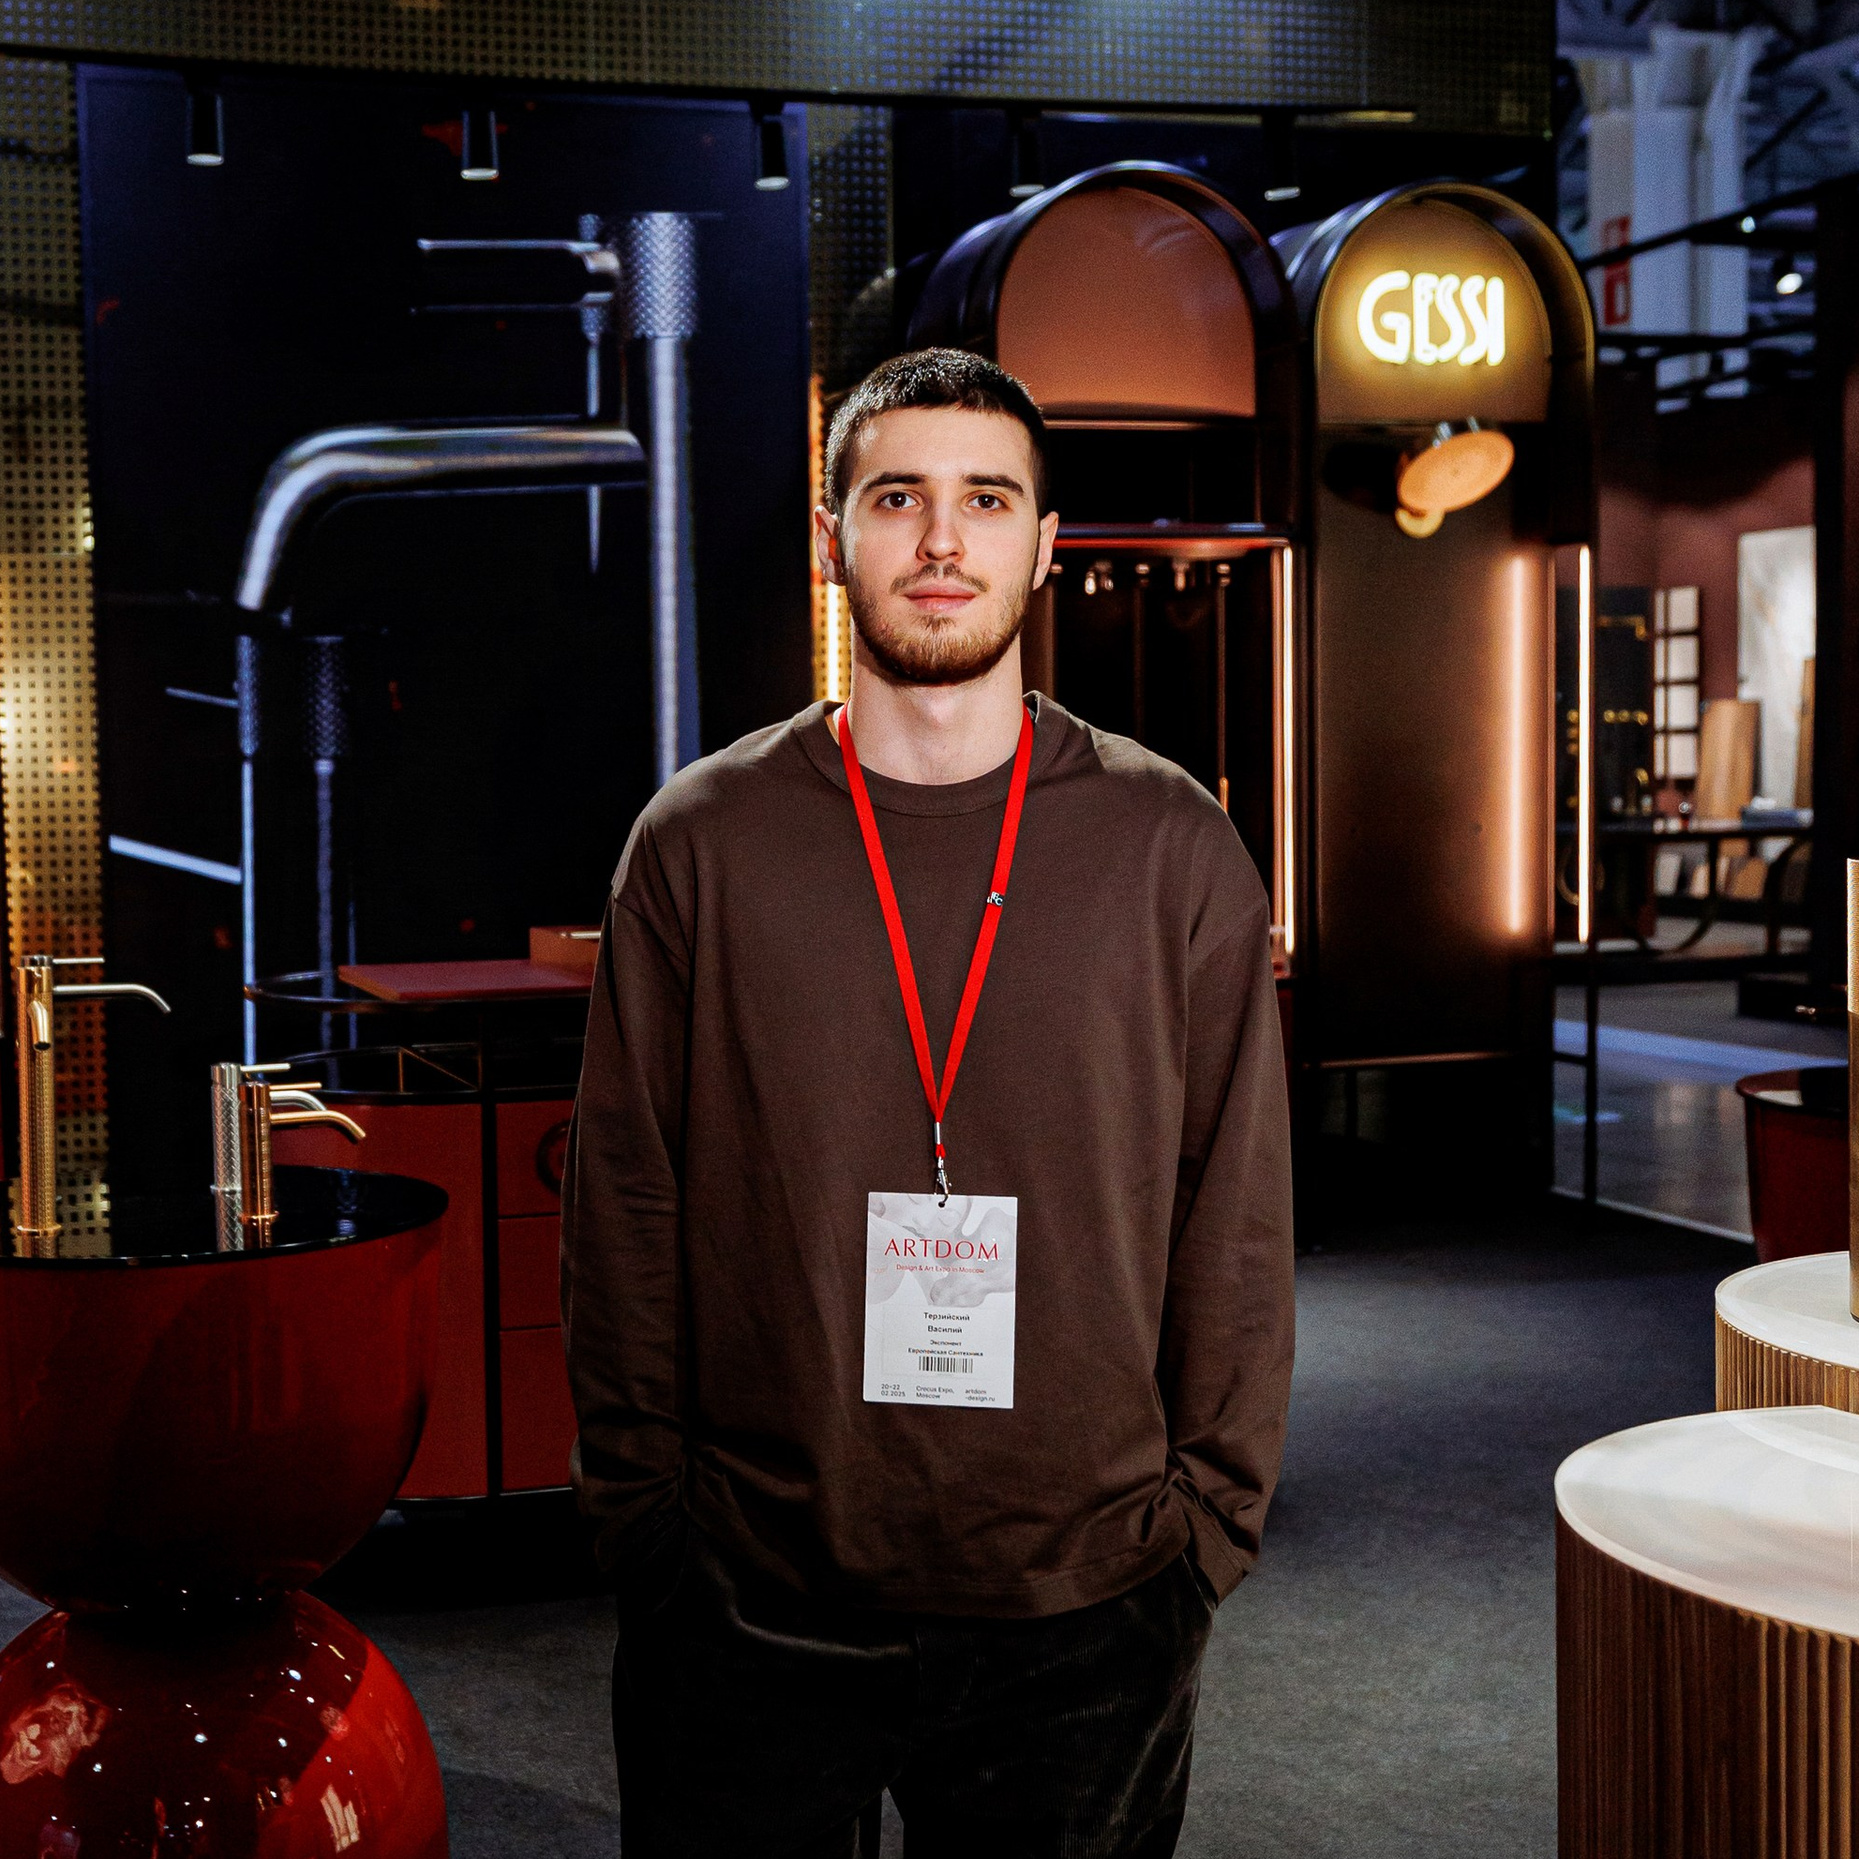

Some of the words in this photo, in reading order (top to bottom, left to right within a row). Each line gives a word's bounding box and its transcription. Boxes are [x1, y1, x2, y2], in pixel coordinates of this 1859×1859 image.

[1356, 269, 1506, 366] GESSI
[884, 1238, 999, 1261] ARTDOM
[896, 1263, 918, 1272] Design
[924, 1264, 934, 1272] Art
[935, 1265, 951, 1273] Expo
[959, 1266, 985, 1274] Moscow
[924, 1312, 970, 1321] Терзийский
[927, 1325, 963, 1334] Василий
[930, 1339, 962, 1347] Экспонент
[908, 1347, 947, 1355] Европейская
[948, 1349, 984, 1357] Сантехника
[915, 1385, 937, 1393] Crocus
